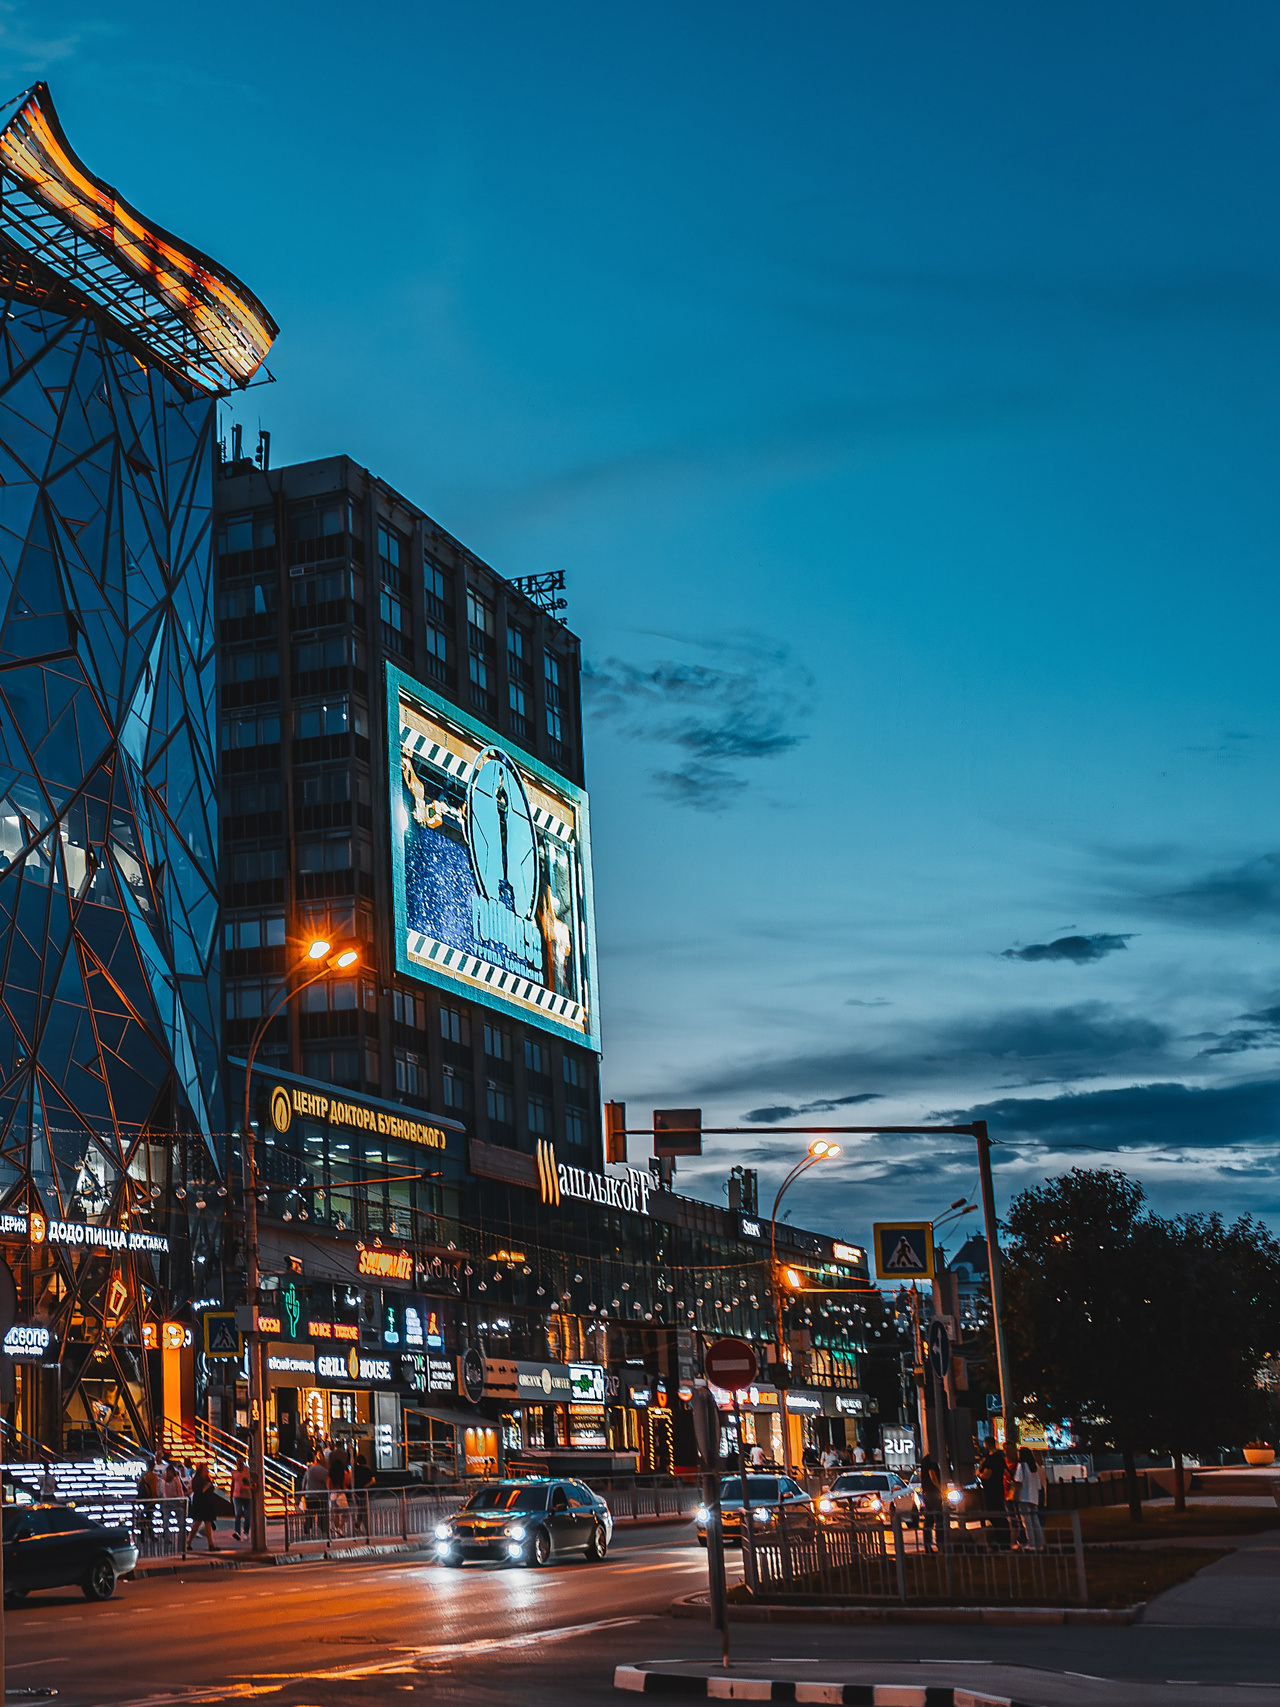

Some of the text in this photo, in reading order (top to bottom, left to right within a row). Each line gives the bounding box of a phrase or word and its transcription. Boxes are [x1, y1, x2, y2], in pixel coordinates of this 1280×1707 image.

[292, 1089, 446, 1149] ЦЕНТР ДОКТОРА БУБНОВСКОГО
[49, 1221, 84, 1244] ДОДО
[85, 1225, 127, 1250] ПИЦЦА
[129, 1232, 169, 1252] ДОСТАВКА
[5, 1327, 49, 1347] ceone
[319, 1356, 348, 1377] GRILL
[360, 1358, 391, 1380] HOUSE
[884, 1439, 914, 1454] 2UP
